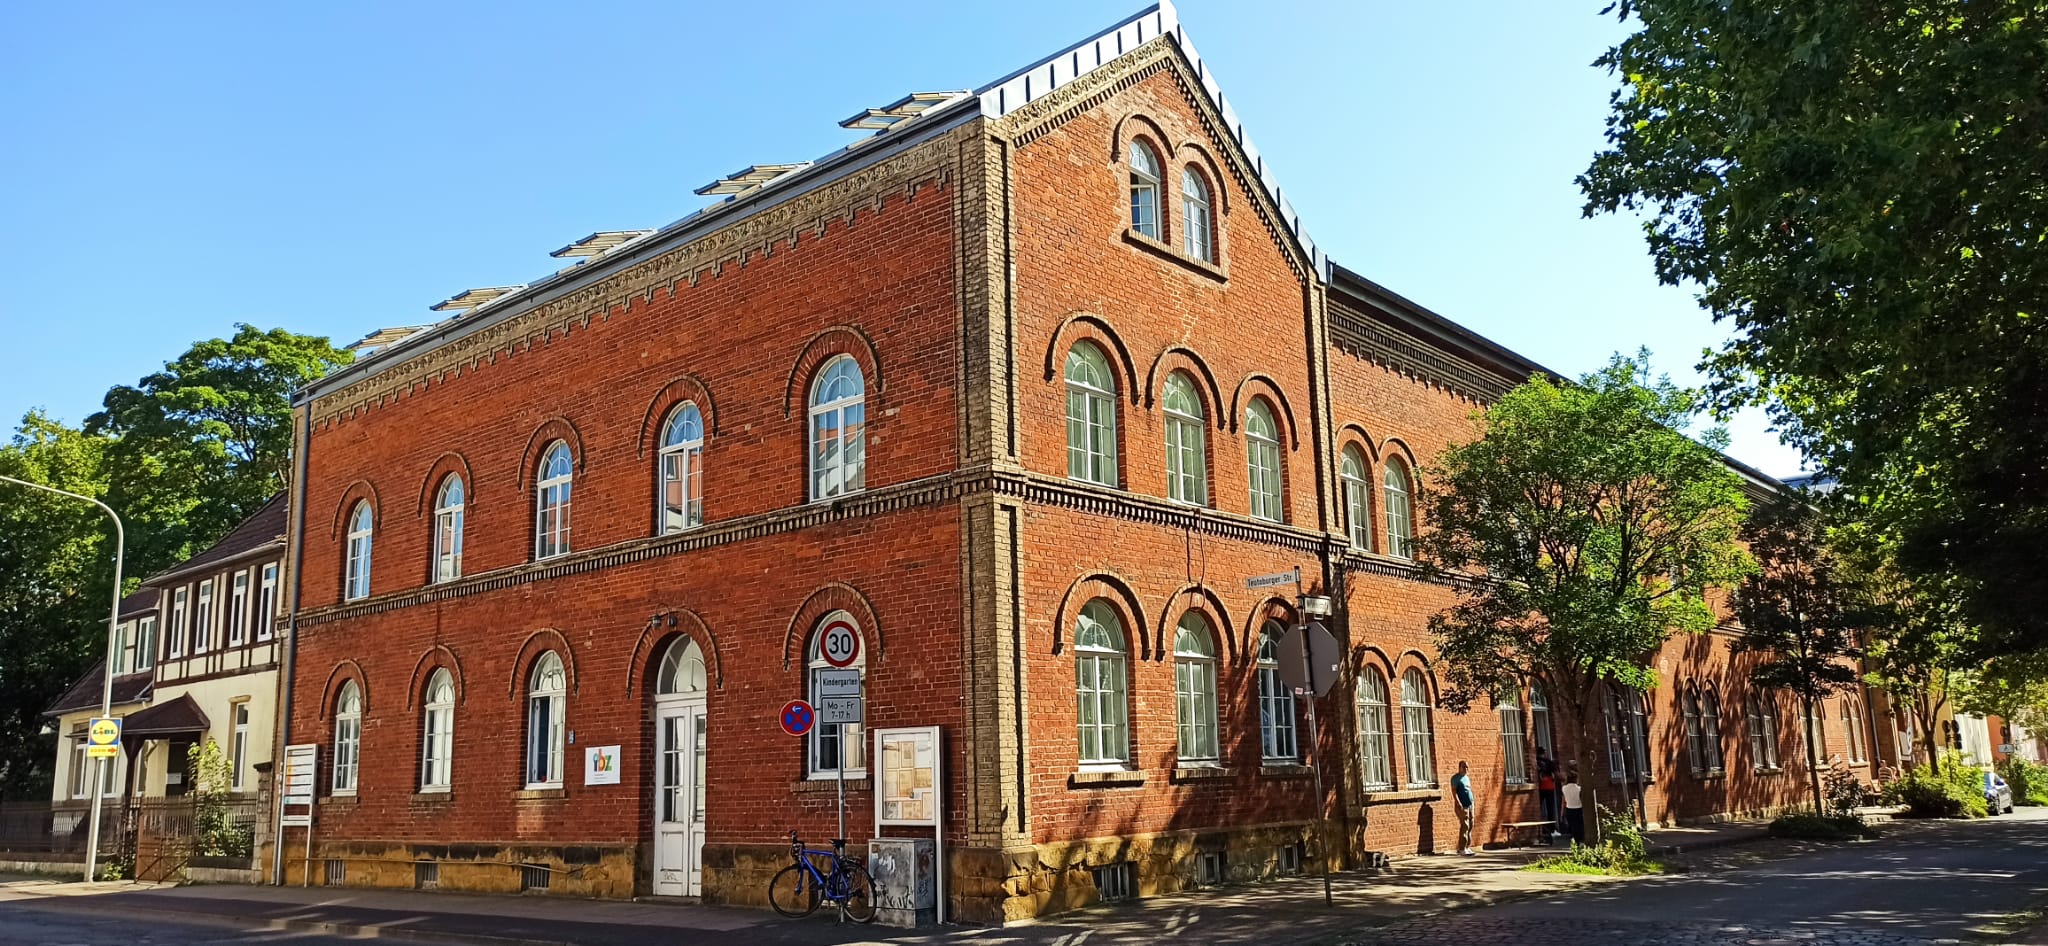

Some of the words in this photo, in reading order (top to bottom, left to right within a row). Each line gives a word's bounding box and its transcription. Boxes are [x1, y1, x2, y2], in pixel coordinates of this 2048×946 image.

[828, 633, 851, 654] 30
[822, 678, 858, 687] Kindergarten
[827, 701, 838, 710] Mo
[846, 701, 855, 709] Fr
[831, 711, 844, 719] 7-17
[593, 748, 612, 772] ibz
